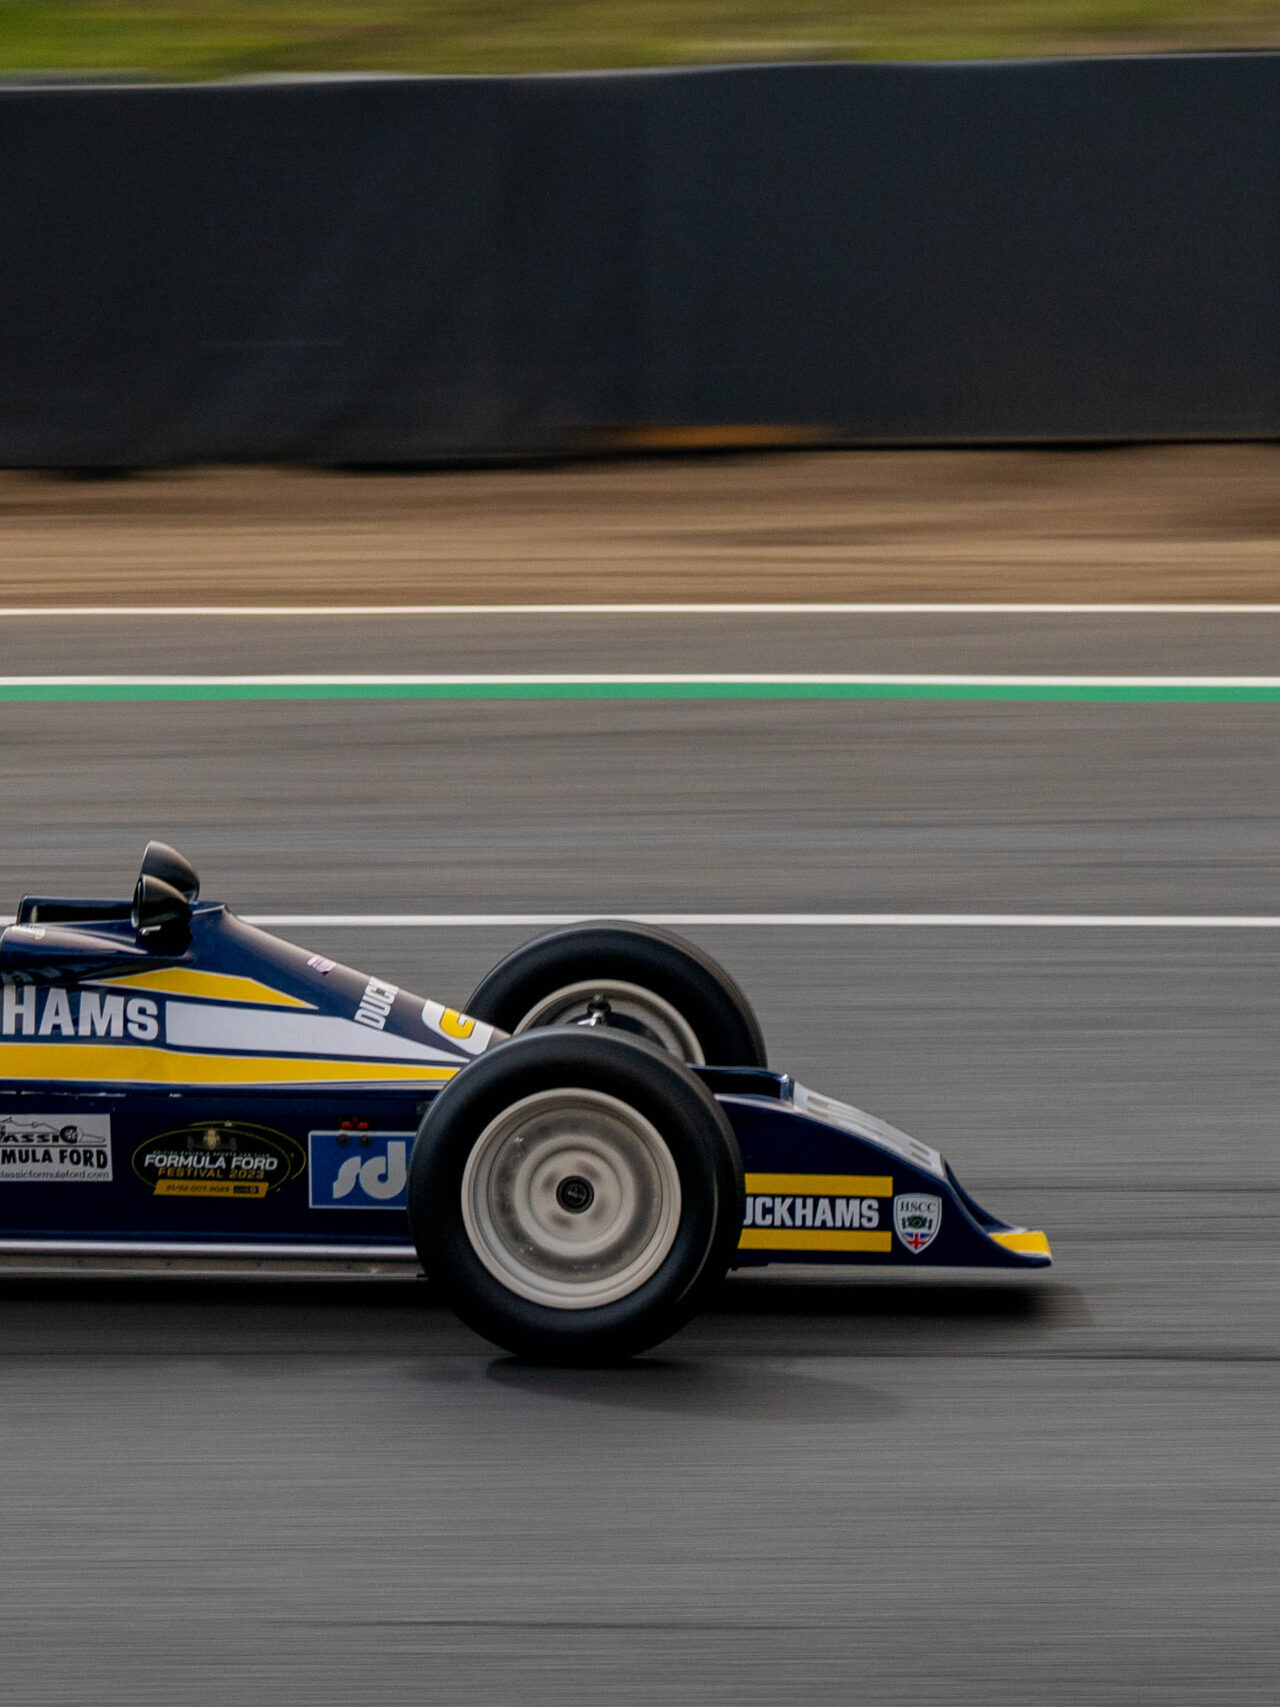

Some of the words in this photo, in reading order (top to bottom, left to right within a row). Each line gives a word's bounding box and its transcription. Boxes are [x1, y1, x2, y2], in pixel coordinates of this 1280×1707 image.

[59, 1148, 109, 1169] FORD
[144, 1153, 226, 1169] FORMULA
[231, 1156, 278, 1171] FORD
[158, 1166, 223, 1178] FESTIVAL
[229, 1168, 265, 1180] 2023
[901, 1201, 937, 1213] HSCC
